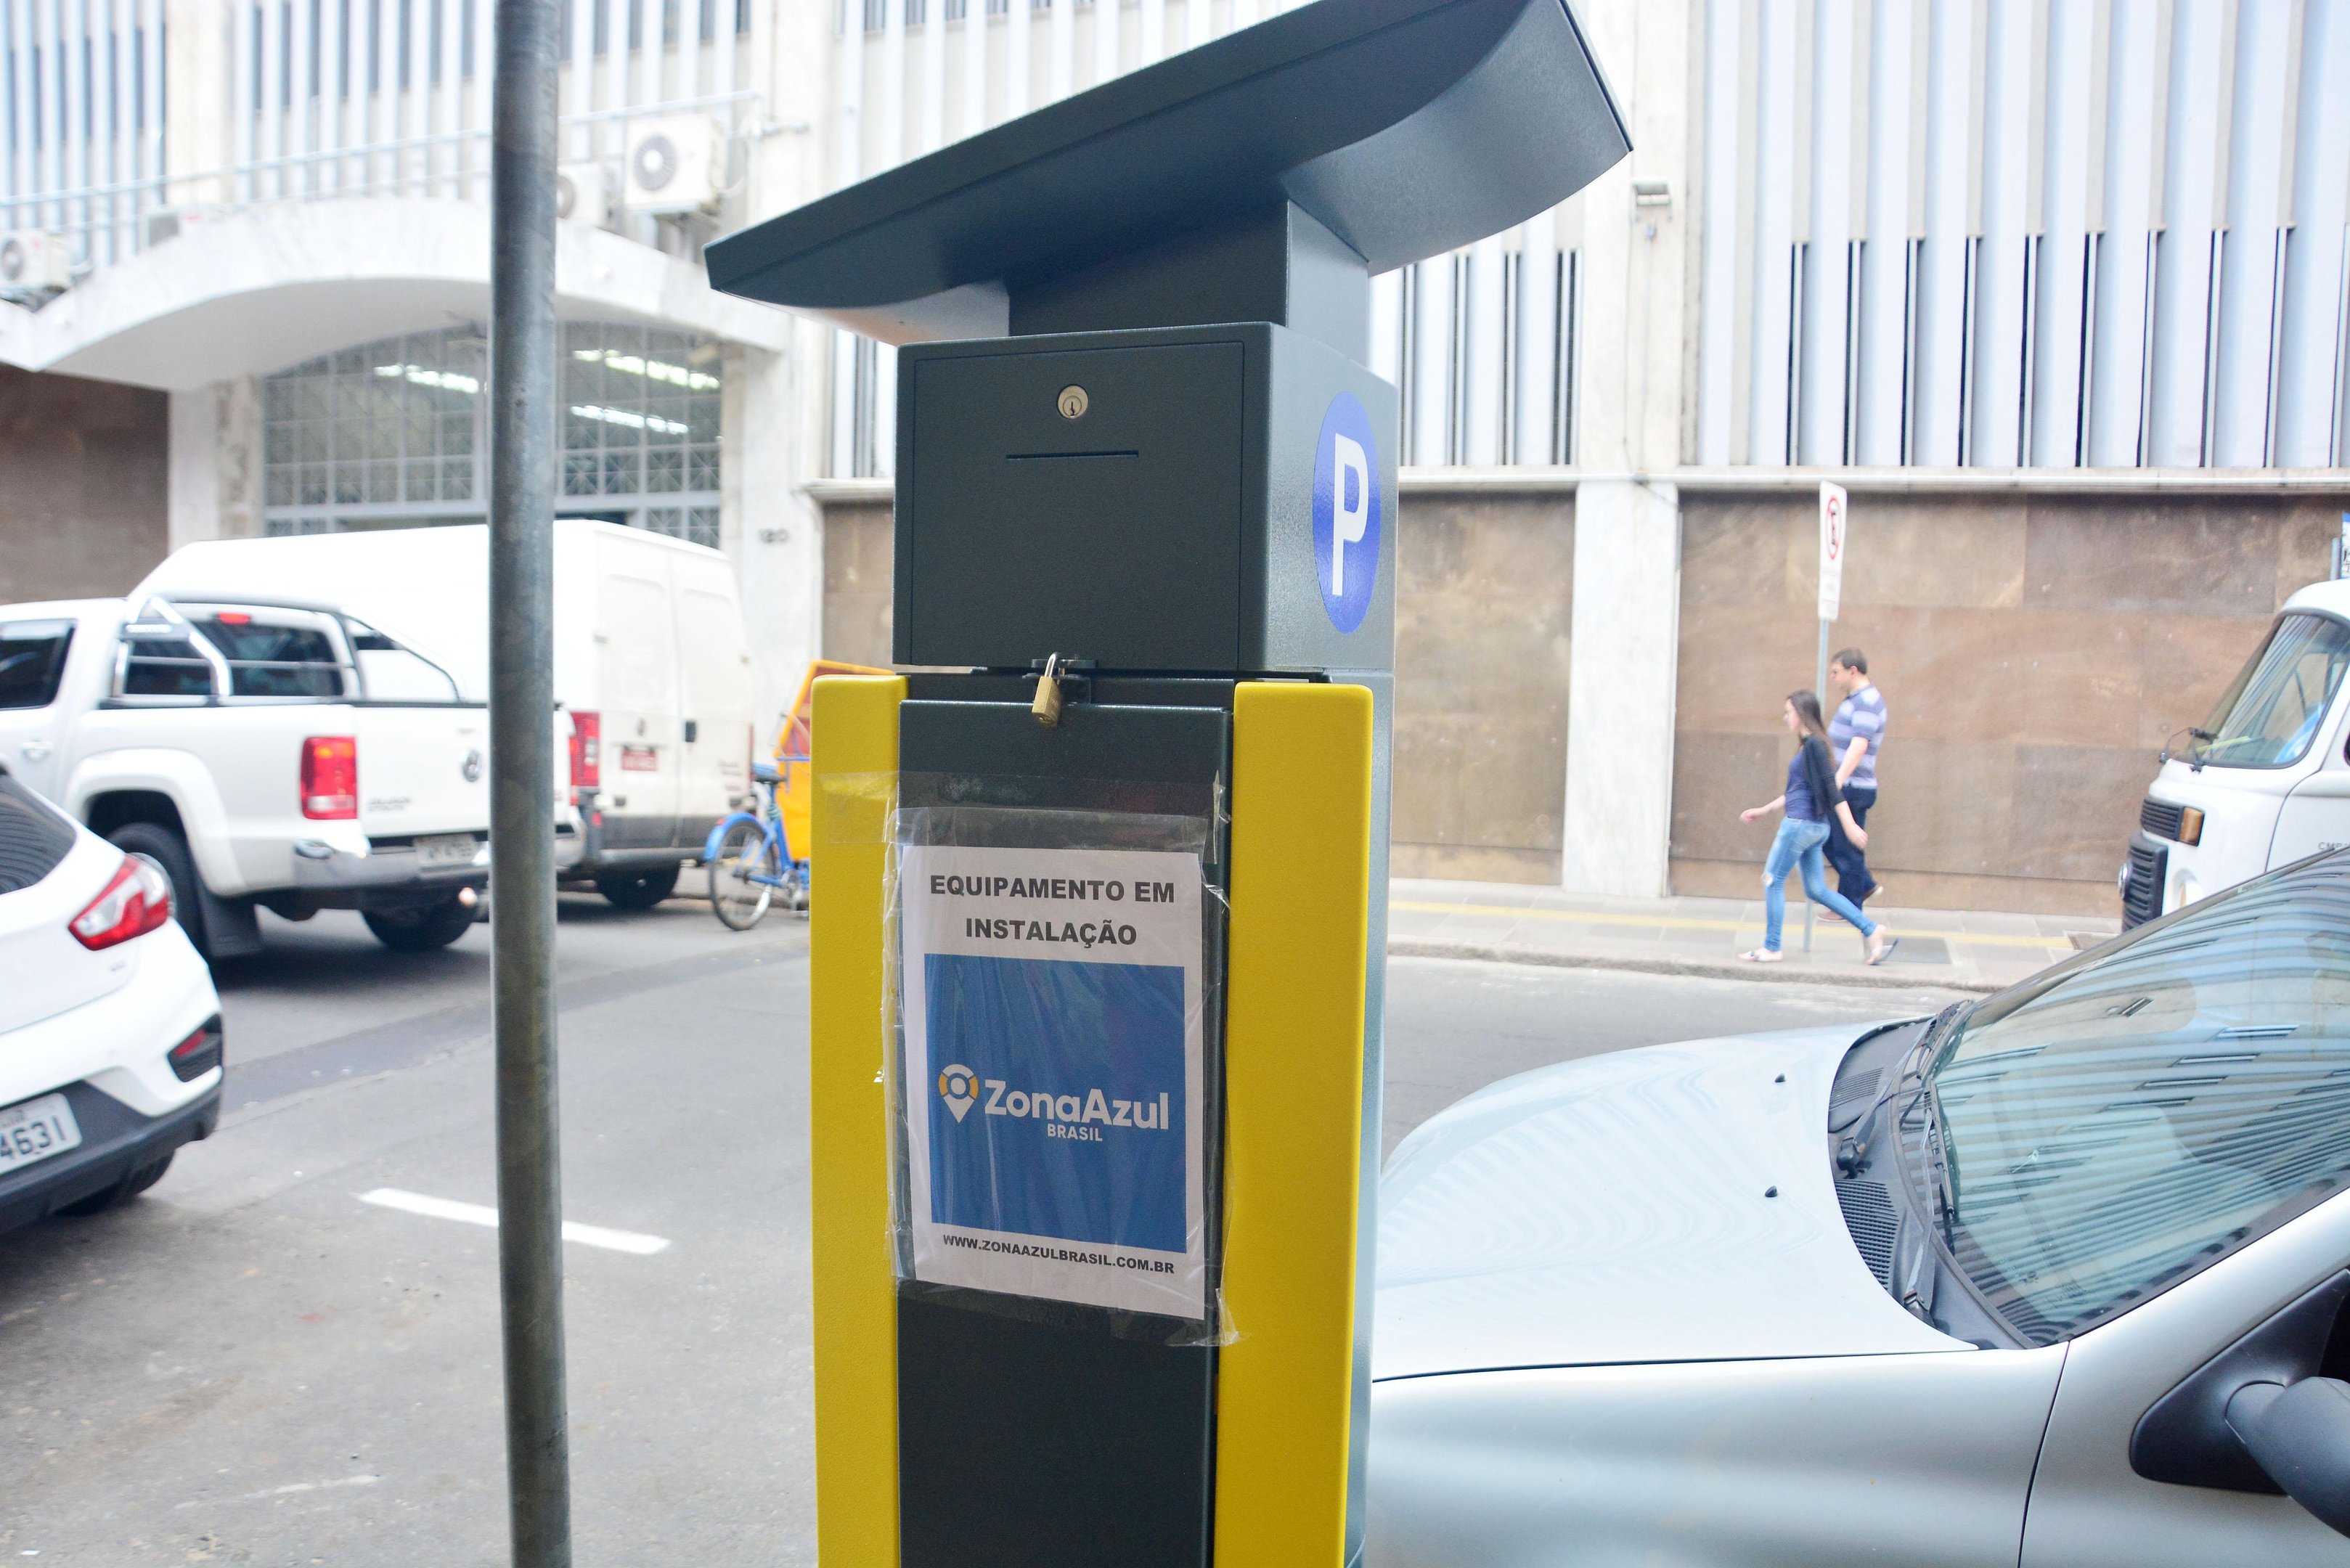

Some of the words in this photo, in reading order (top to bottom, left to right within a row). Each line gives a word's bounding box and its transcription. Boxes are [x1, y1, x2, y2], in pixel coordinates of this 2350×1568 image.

[1331, 433, 1369, 597] P
[930, 874, 1125, 902] EQUIPAMENTO
[1134, 881, 1175, 903] EM
[966, 918, 1137, 949] INSTALAÇÃO
[984, 1079, 1169, 1130] ZonaAzul
[1047, 1123, 1103, 1142] BRASIL
[943, 1234, 1175, 1274] WWW.ZONAAZULBRASIL.COM.BR
